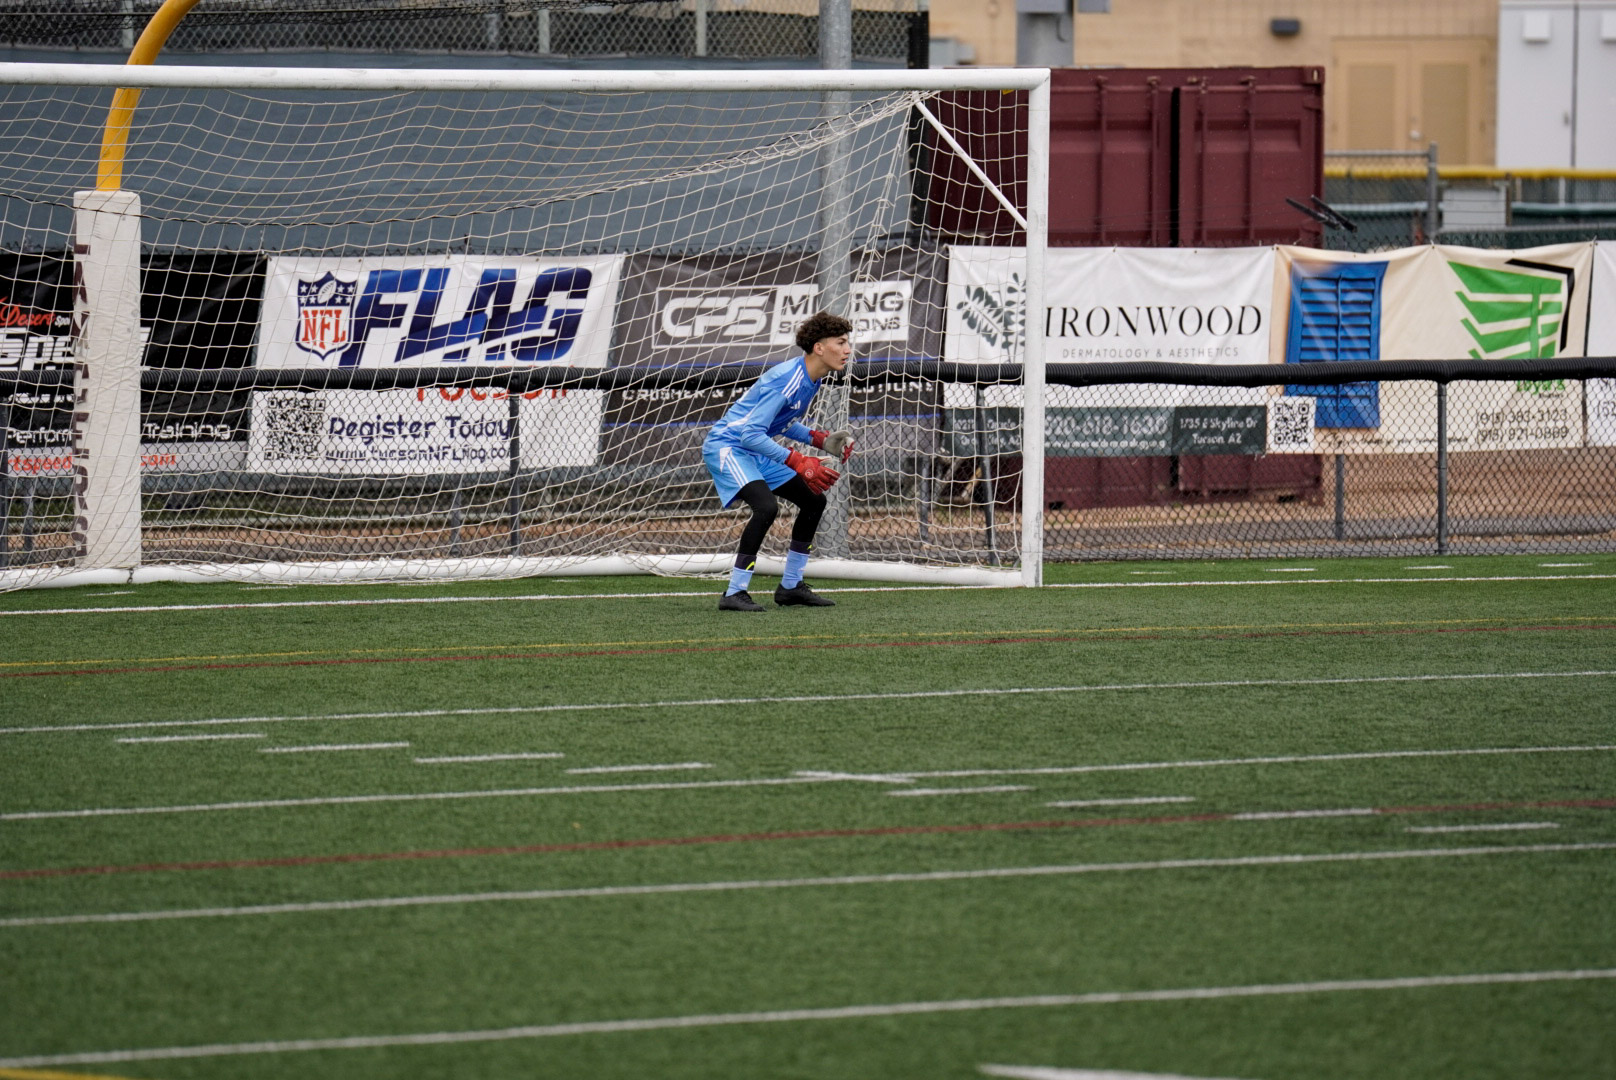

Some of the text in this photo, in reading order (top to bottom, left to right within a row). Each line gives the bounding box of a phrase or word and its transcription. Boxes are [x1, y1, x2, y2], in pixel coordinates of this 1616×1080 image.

[301, 267, 593, 370] NFL FLAG
[662, 296, 769, 338] CPS
[780, 291, 904, 316] MING
[1045, 305, 1262, 337] IRONWOOD
[1062, 346, 1239, 359] DERMATOLOGY & AESTHETICS
[143, 422, 230, 440] Training
[328, 415, 510, 446] Register Today
